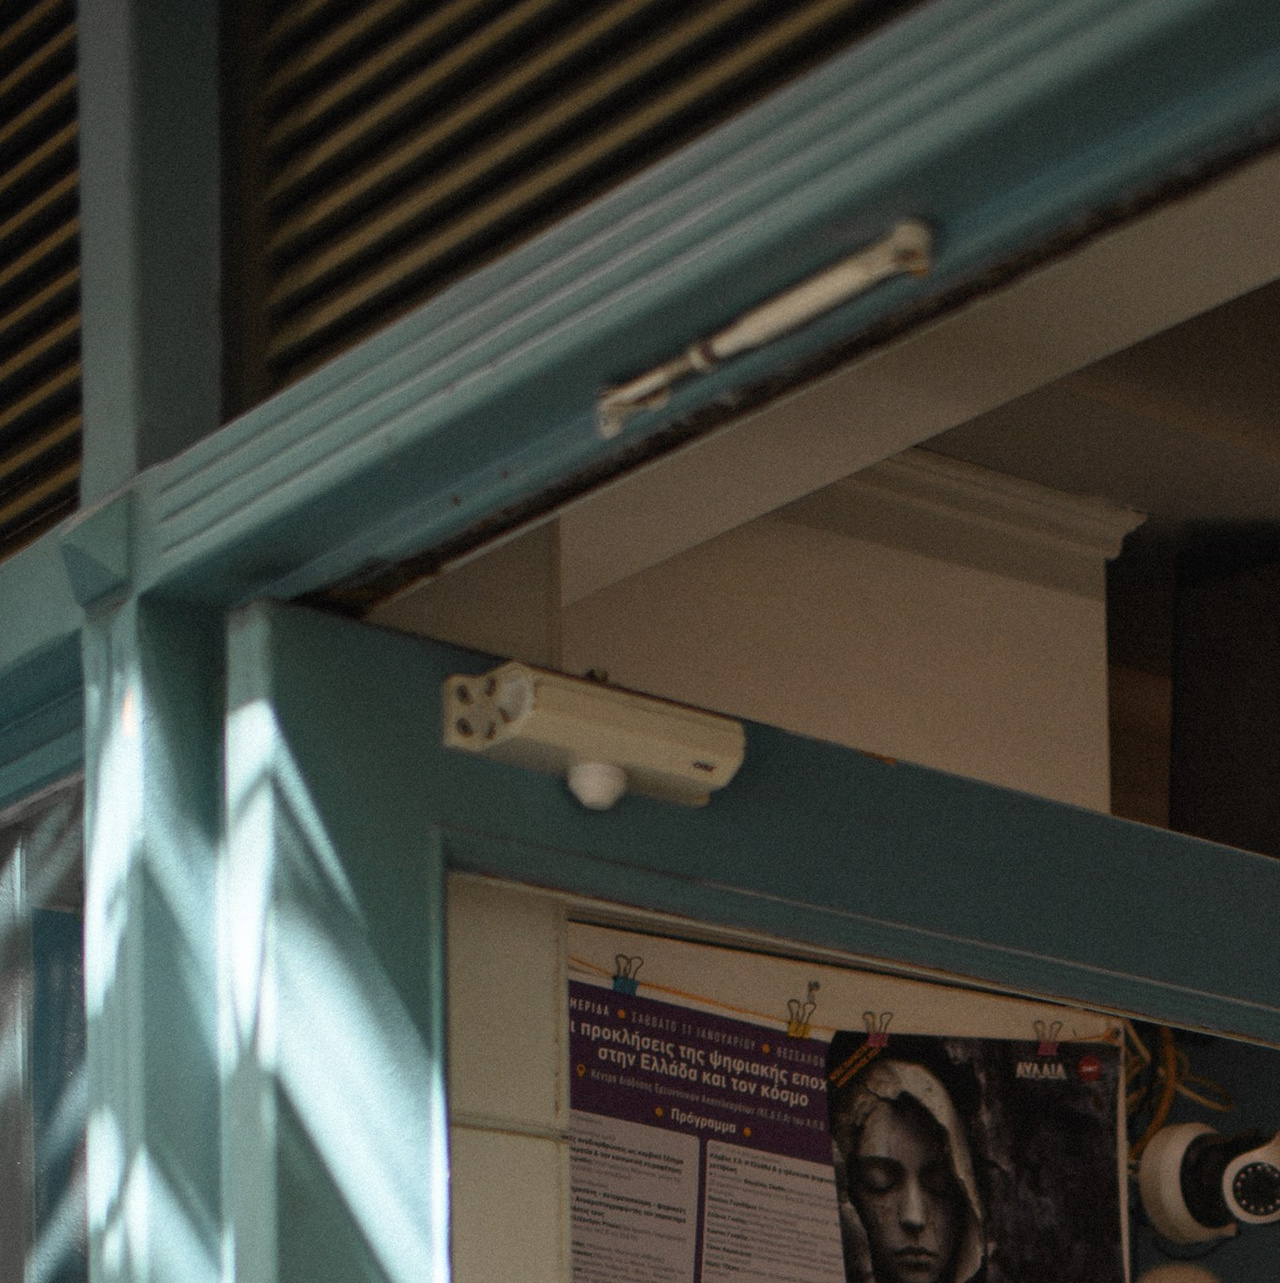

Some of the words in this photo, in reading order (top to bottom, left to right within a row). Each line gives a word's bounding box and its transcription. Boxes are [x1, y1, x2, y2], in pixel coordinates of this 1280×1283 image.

[570, 996, 610, 1016] ΜΕΡΙΔΑ
[580, 1022, 675, 1058] προκλήσεις
[678, 1044, 704, 1063] της
[709, 1050, 788, 1084] ψηφιακής
[598, 1048, 636, 1069] στην
[640, 1053, 698, 1083] Ελλάδα
[702, 1072, 727, 1089] και
[731, 1077, 756, 1095] τον
[760, 1084, 810, 1108] κόσμο
[670, 1107, 737, 1133] Πρόγραμμα
